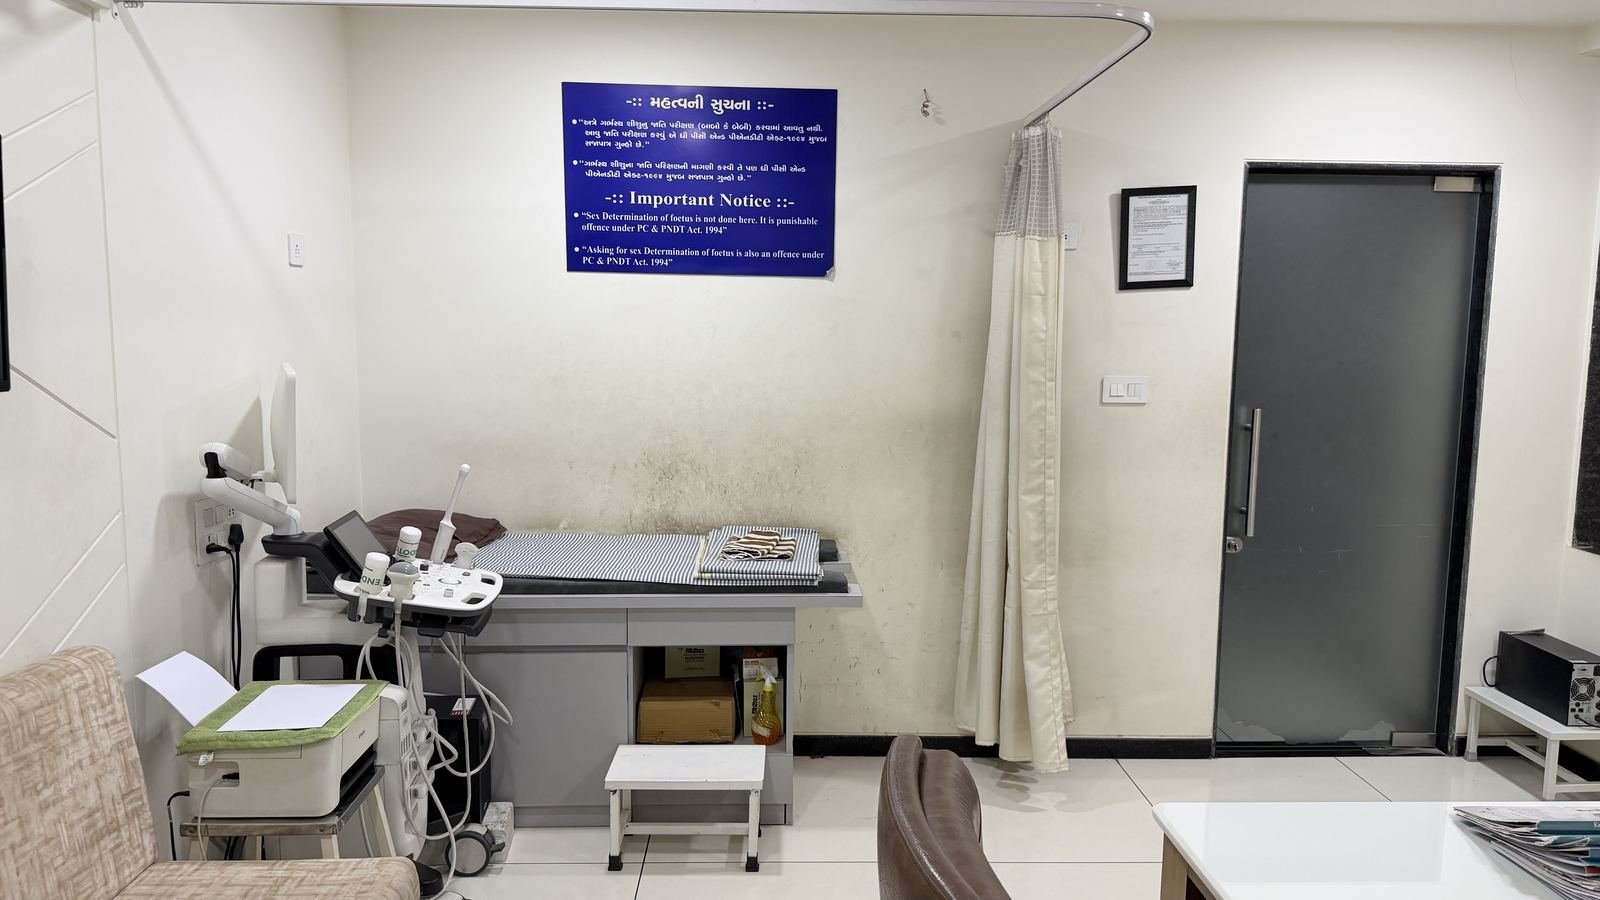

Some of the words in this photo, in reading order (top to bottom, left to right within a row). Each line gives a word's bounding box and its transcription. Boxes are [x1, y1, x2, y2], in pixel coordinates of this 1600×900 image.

[630, 191, 715, 208] Important
[719, 193, 771, 208] Notice
[602, 212, 658, 222] Determination
[660, 214, 669, 222] of
[670, 214, 694, 223] foetus
[695, 214, 702, 222] is
[703, 215, 716, 223] not
[718, 215, 737, 224] done
[738, 216, 758, 224] here.
[760, 216, 766, 224] It
[768, 216, 775, 224] is
[776, 217, 819, 227] punishable
[581, 222, 610, 231] offence
[612, 223, 635, 232] under
[637, 224, 650, 233] PC
[651, 225, 659, 233] &
[661, 225, 685, 234] PNDT
[687, 226, 703, 234] Act.
[616, 246, 627, 254] for
[644, 247, 700, 256] Determination
[711, 249, 735, 257] foetus
[736, 249, 743, 257] is
[744, 249, 760, 257] also
[772, 250, 801, 258] offence
[802, 250, 825, 259] under
[582, 256, 594, 265] PC
[596, 257, 604, 265] &
[606, 257, 632, 265] PNDT
[633, 258, 649, 266] Act.
